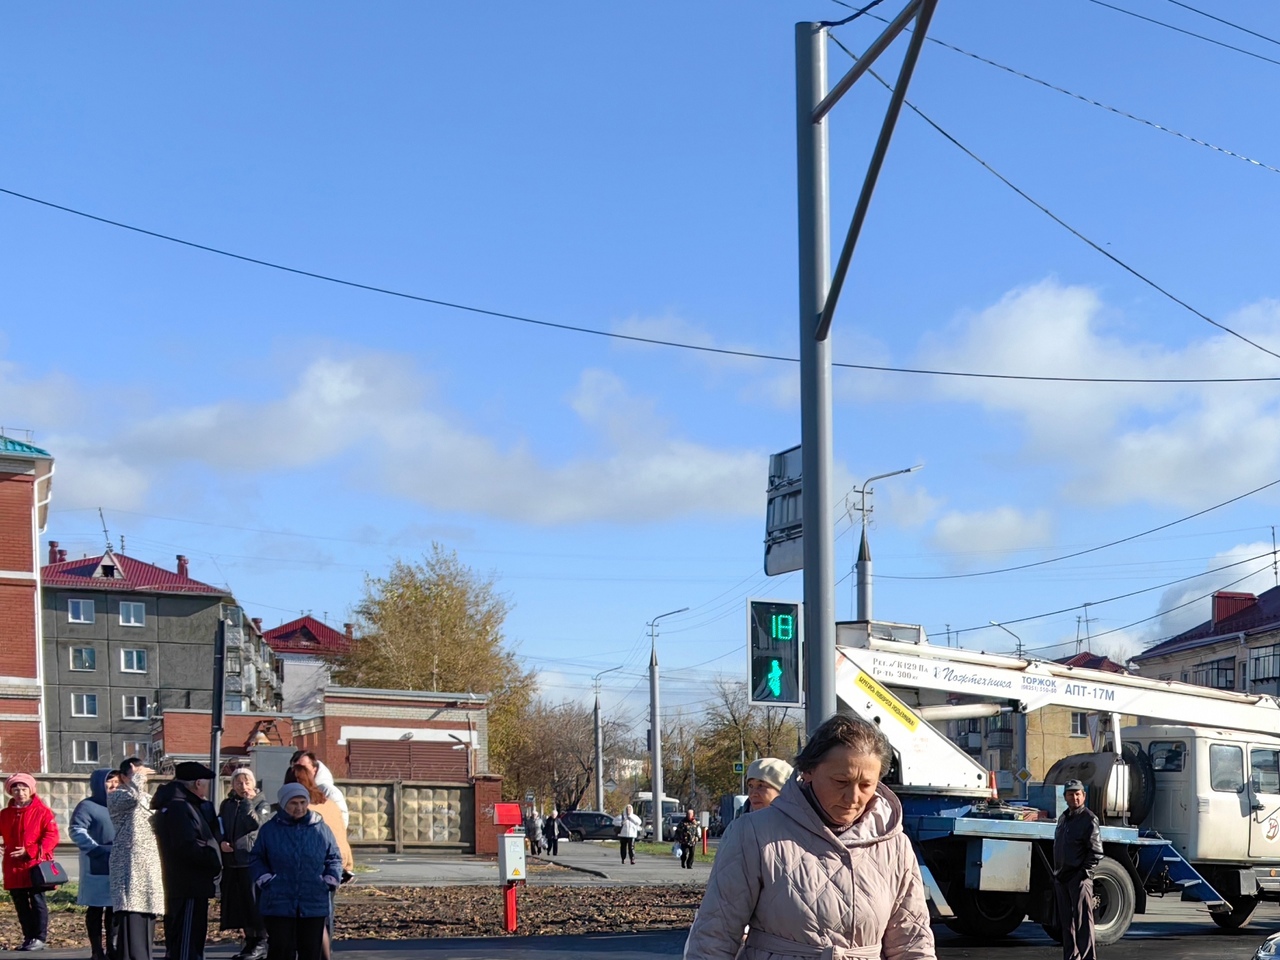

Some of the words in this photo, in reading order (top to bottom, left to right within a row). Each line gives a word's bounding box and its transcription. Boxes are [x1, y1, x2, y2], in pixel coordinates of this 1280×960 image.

[772, 614, 793, 639] 18
[943, 667, 1012, 690] Пожтехника
[1022, 676, 1057, 688] ТОРЖОК
[1065, 683, 1115, 701] АПТ-17М
